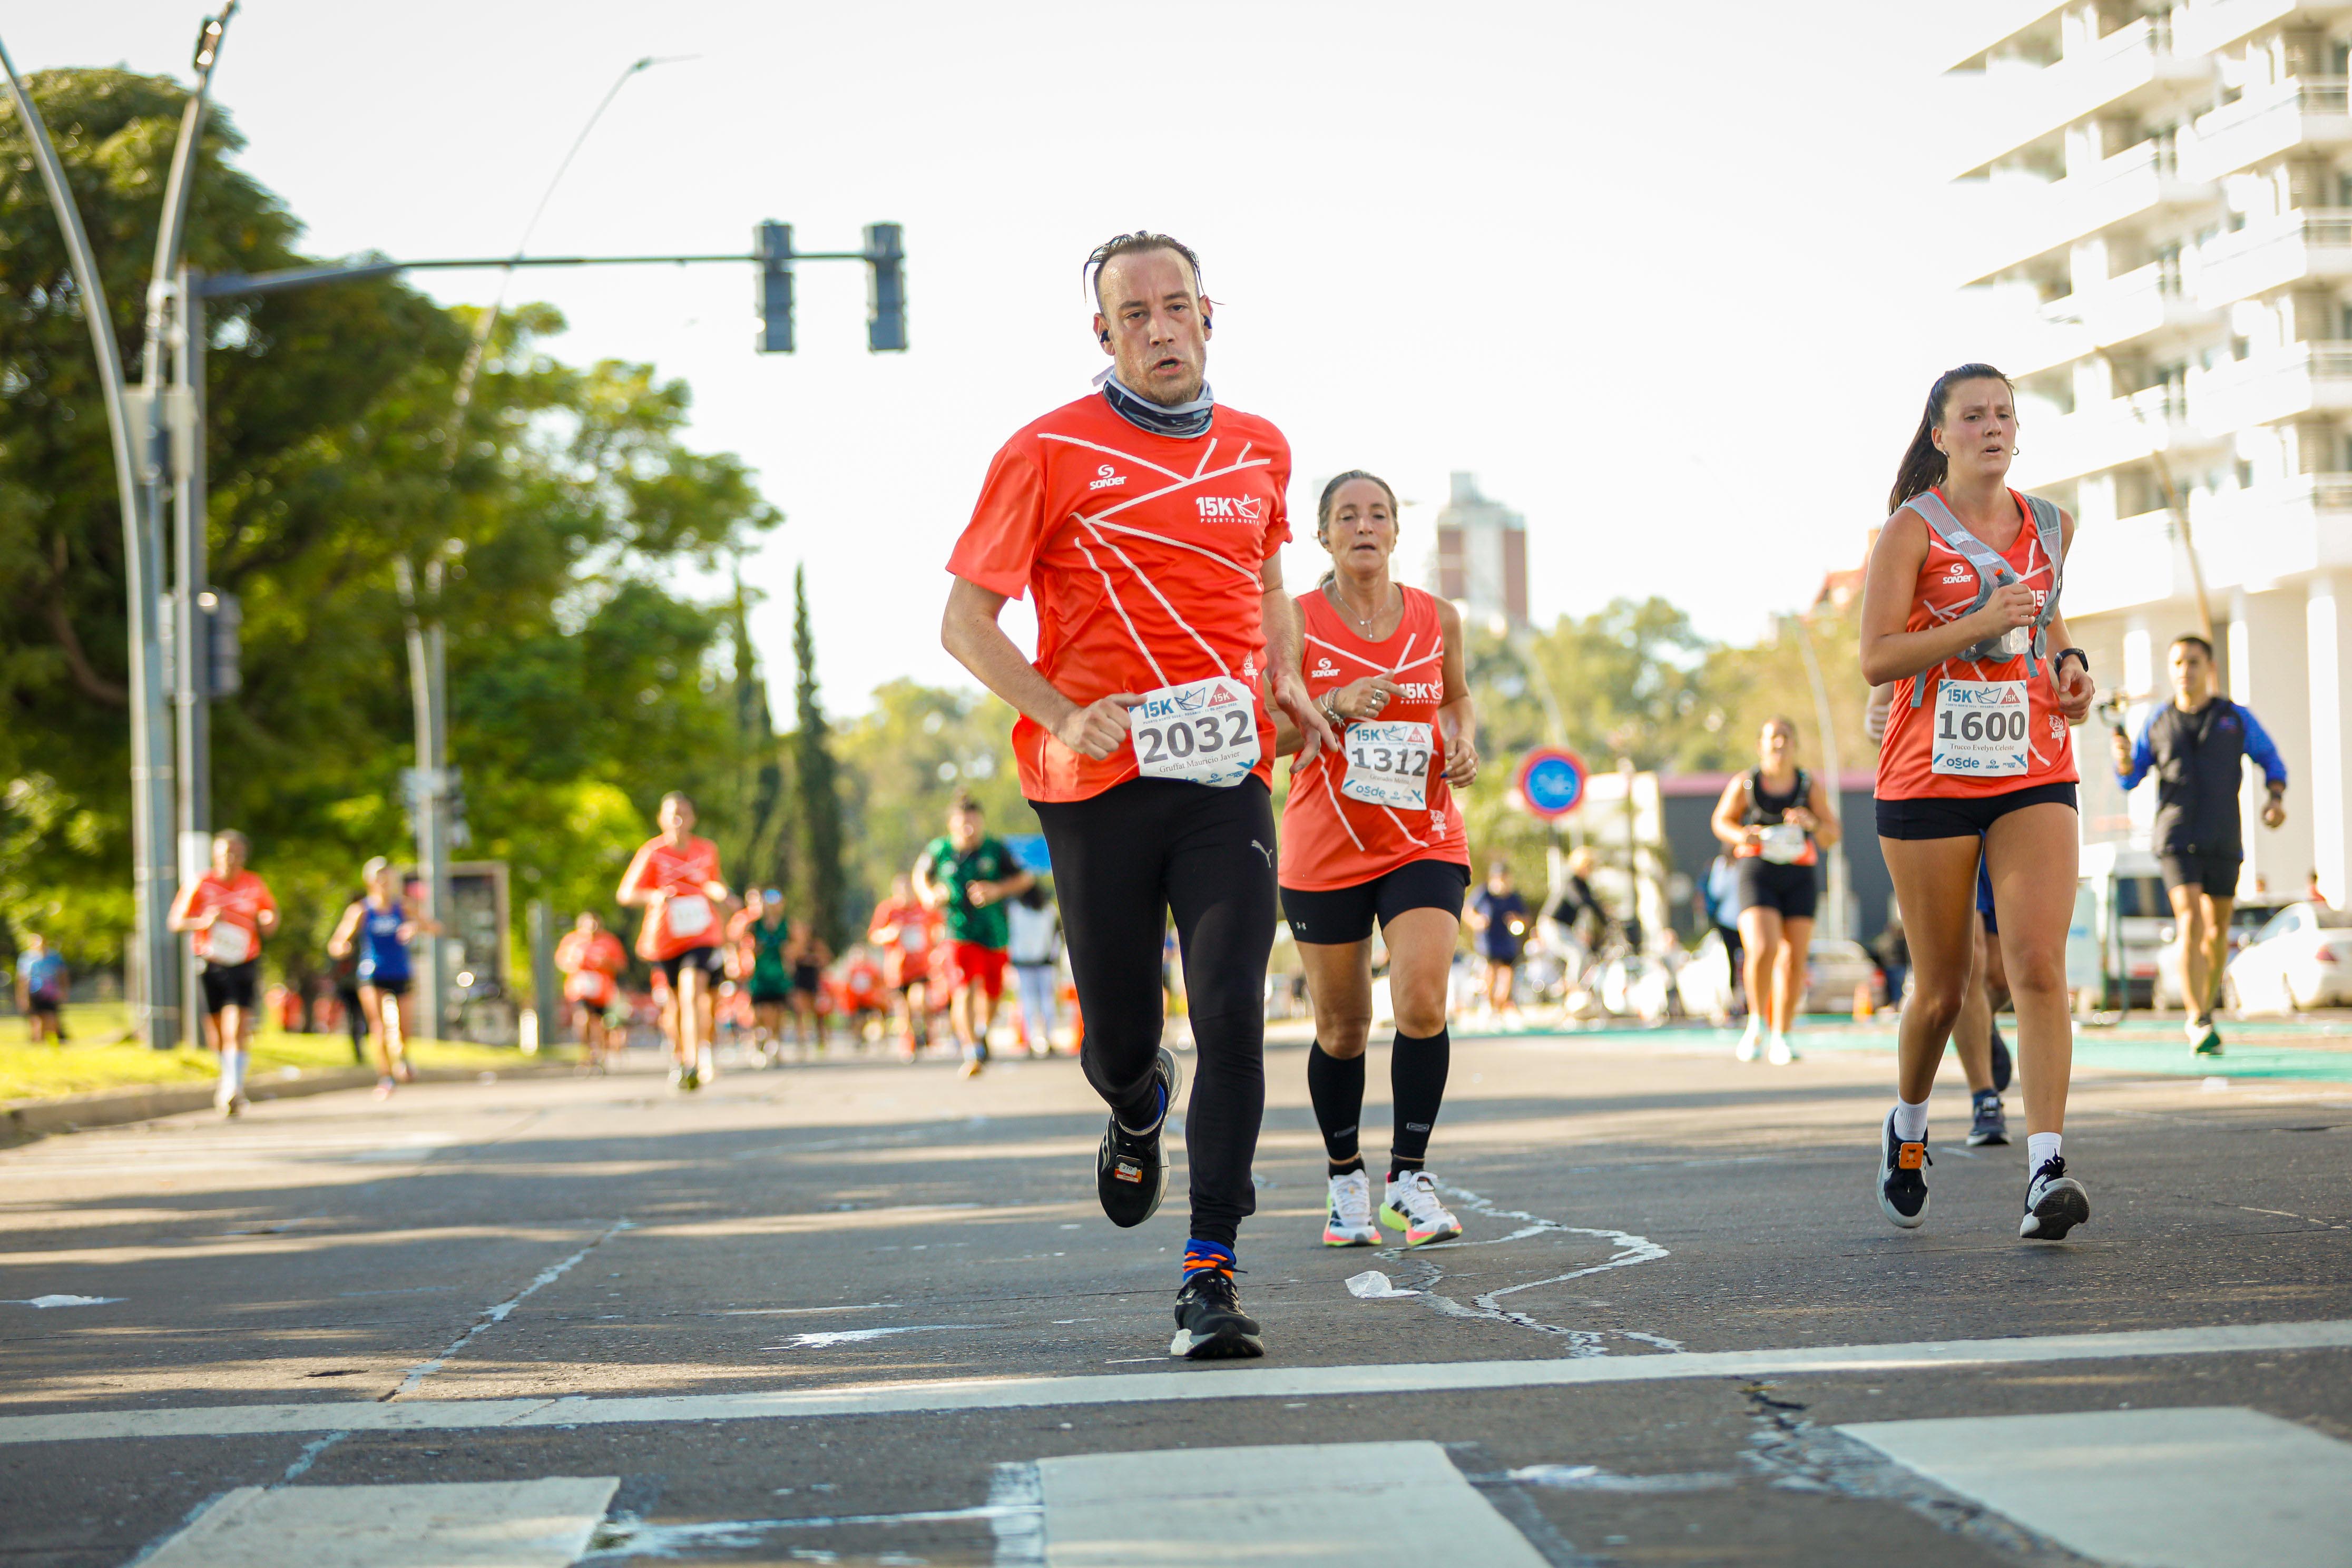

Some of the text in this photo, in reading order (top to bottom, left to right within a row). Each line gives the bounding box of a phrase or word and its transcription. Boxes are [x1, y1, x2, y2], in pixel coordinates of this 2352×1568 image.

[1196, 497, 1234, 516] 15K
[1213, 692, 1231, 702] 15K
[1947, 689, 1973, 703] 15K
[1141, 698, 1174, 719] 15K
[1938, 710, 2025, 741] 1600
[1139, 710, 1253, 764] 2032
[1355, 729, 1380, 741] 15K
[1973, 744, 1993, 752] Evelyn
[1159, 751, 1240, 773] Gruffat Mauricio Javier
[1352, 748, 1428, 777] 1312
[1946, 757, 1980, 769] osde
[1356, 785, 1385, 798] osde
